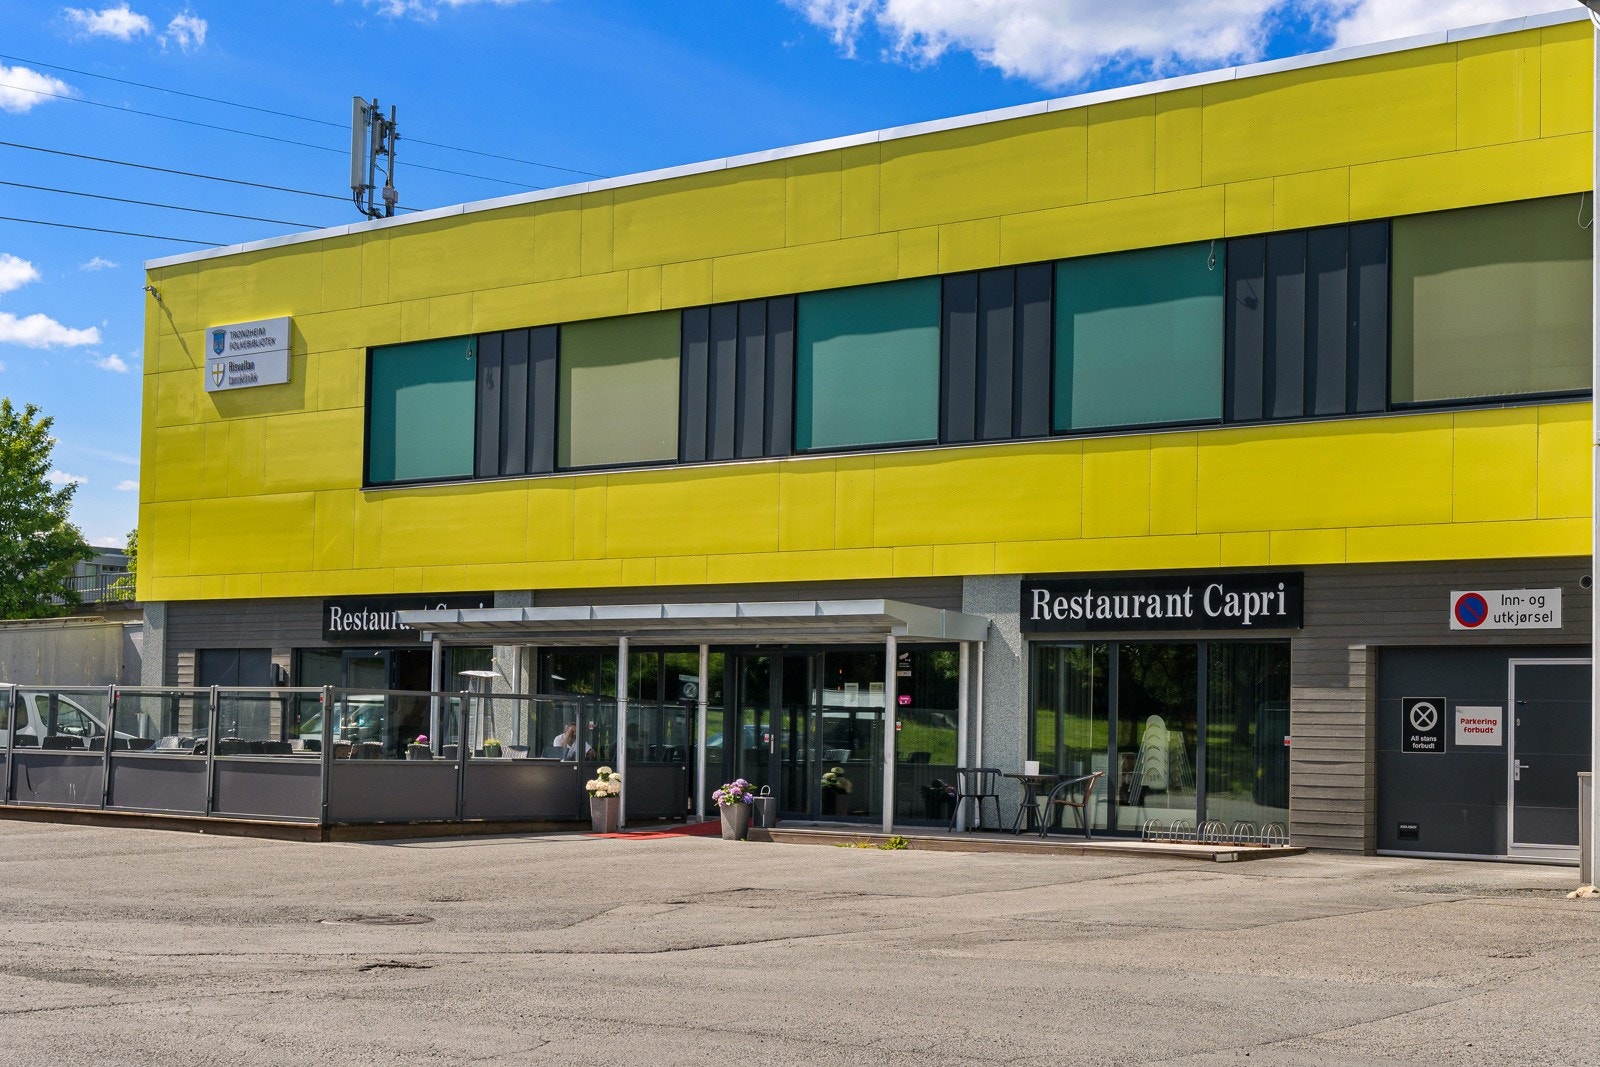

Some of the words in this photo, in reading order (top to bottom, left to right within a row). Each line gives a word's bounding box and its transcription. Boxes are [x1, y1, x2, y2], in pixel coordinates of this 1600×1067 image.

[1030, 586, 1193, 620] Restaurant
[1203, 582, 1286, 624] Capri
[1501, 594, 1525, 606] Inn-
[1529, 595, 1545, 608] og
[1493, 611, 1553, 626] utkjørsel
[1460, 718, 1497, 726] Parkering
[1463, 726, 1494, 734] forbudt
